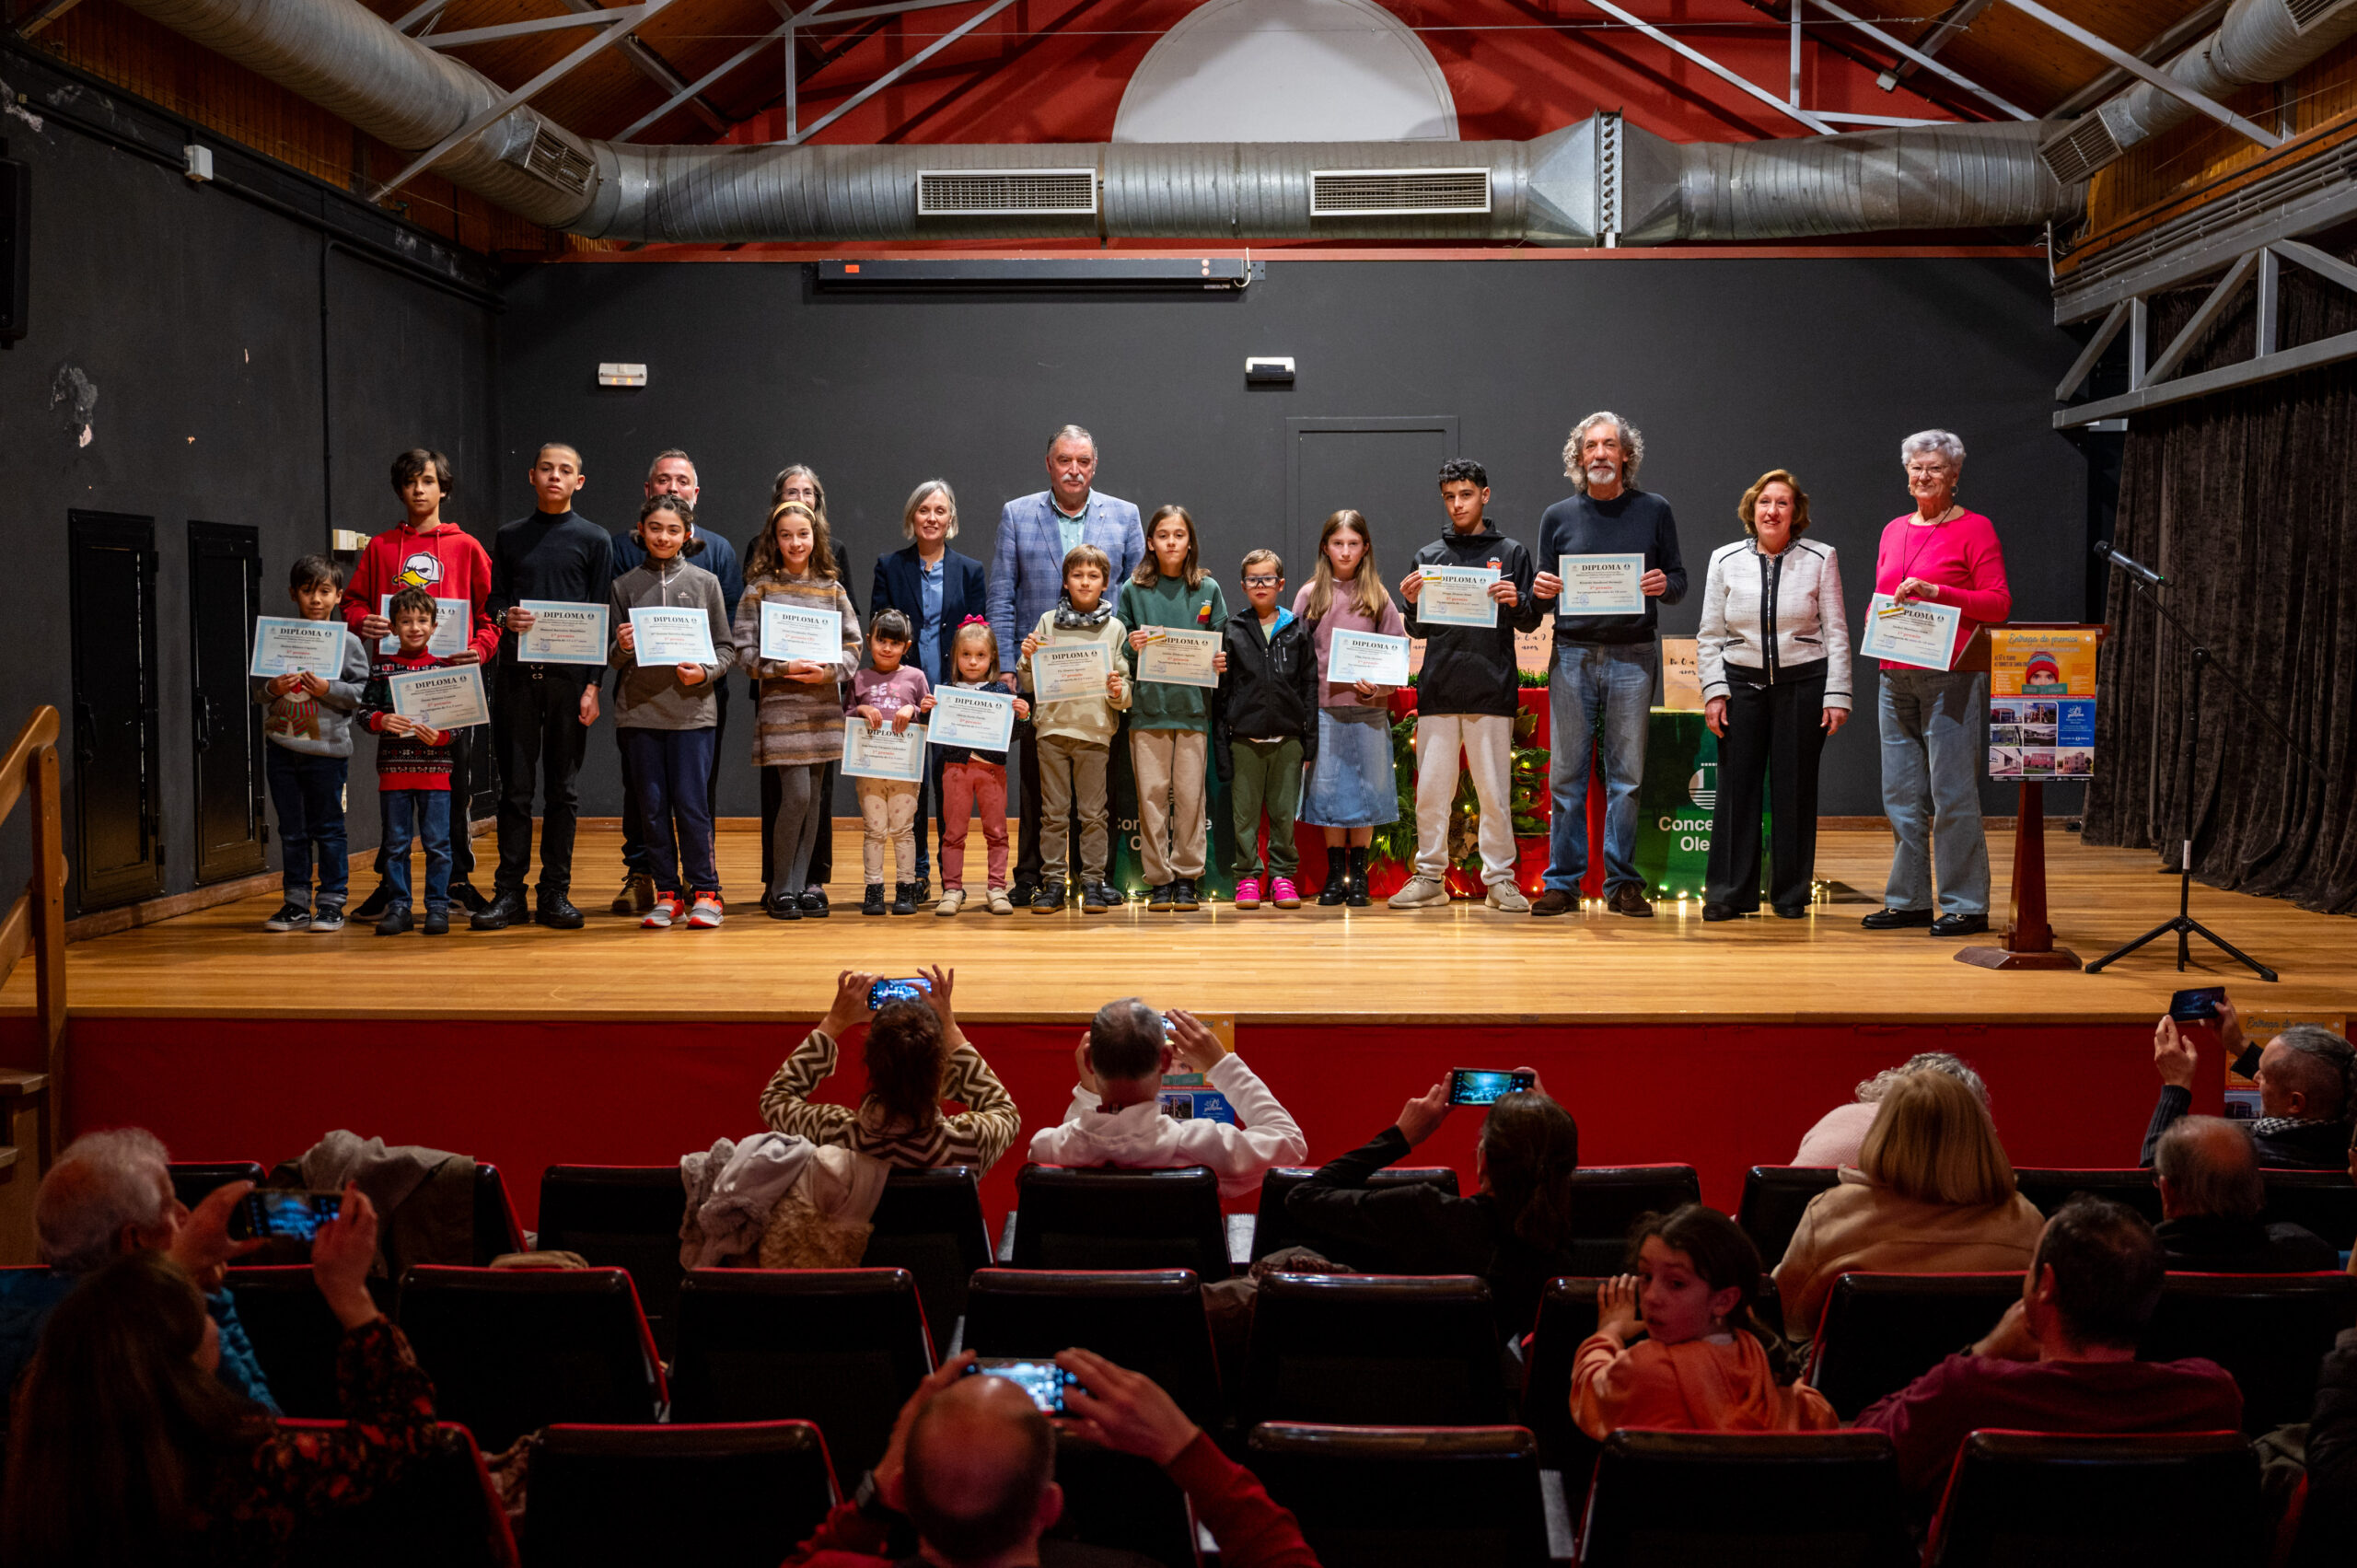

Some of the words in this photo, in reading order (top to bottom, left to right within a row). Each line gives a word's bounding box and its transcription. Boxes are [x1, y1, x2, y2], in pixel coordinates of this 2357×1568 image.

[783, 613, 819, 624] DIPLOMA
[1901, 610, 1934, 621] PLOMA
[280, 628, 322, 637] DIPLOMA
[2008, 633, 2038, 645] Entrega
[2040, 633, 2049, 643] de
[2051, 635, 2078, 645] premios
[1352, 640, 1388, 650] DIPLOMA
[1051, 651, 1089, 659] DIPLOMA
[414, 678, 457, 689] DIPLOMA
[954, 697, 993, 708] DIPLOMA
[867, 729, 904, 738] DIPLOMA
